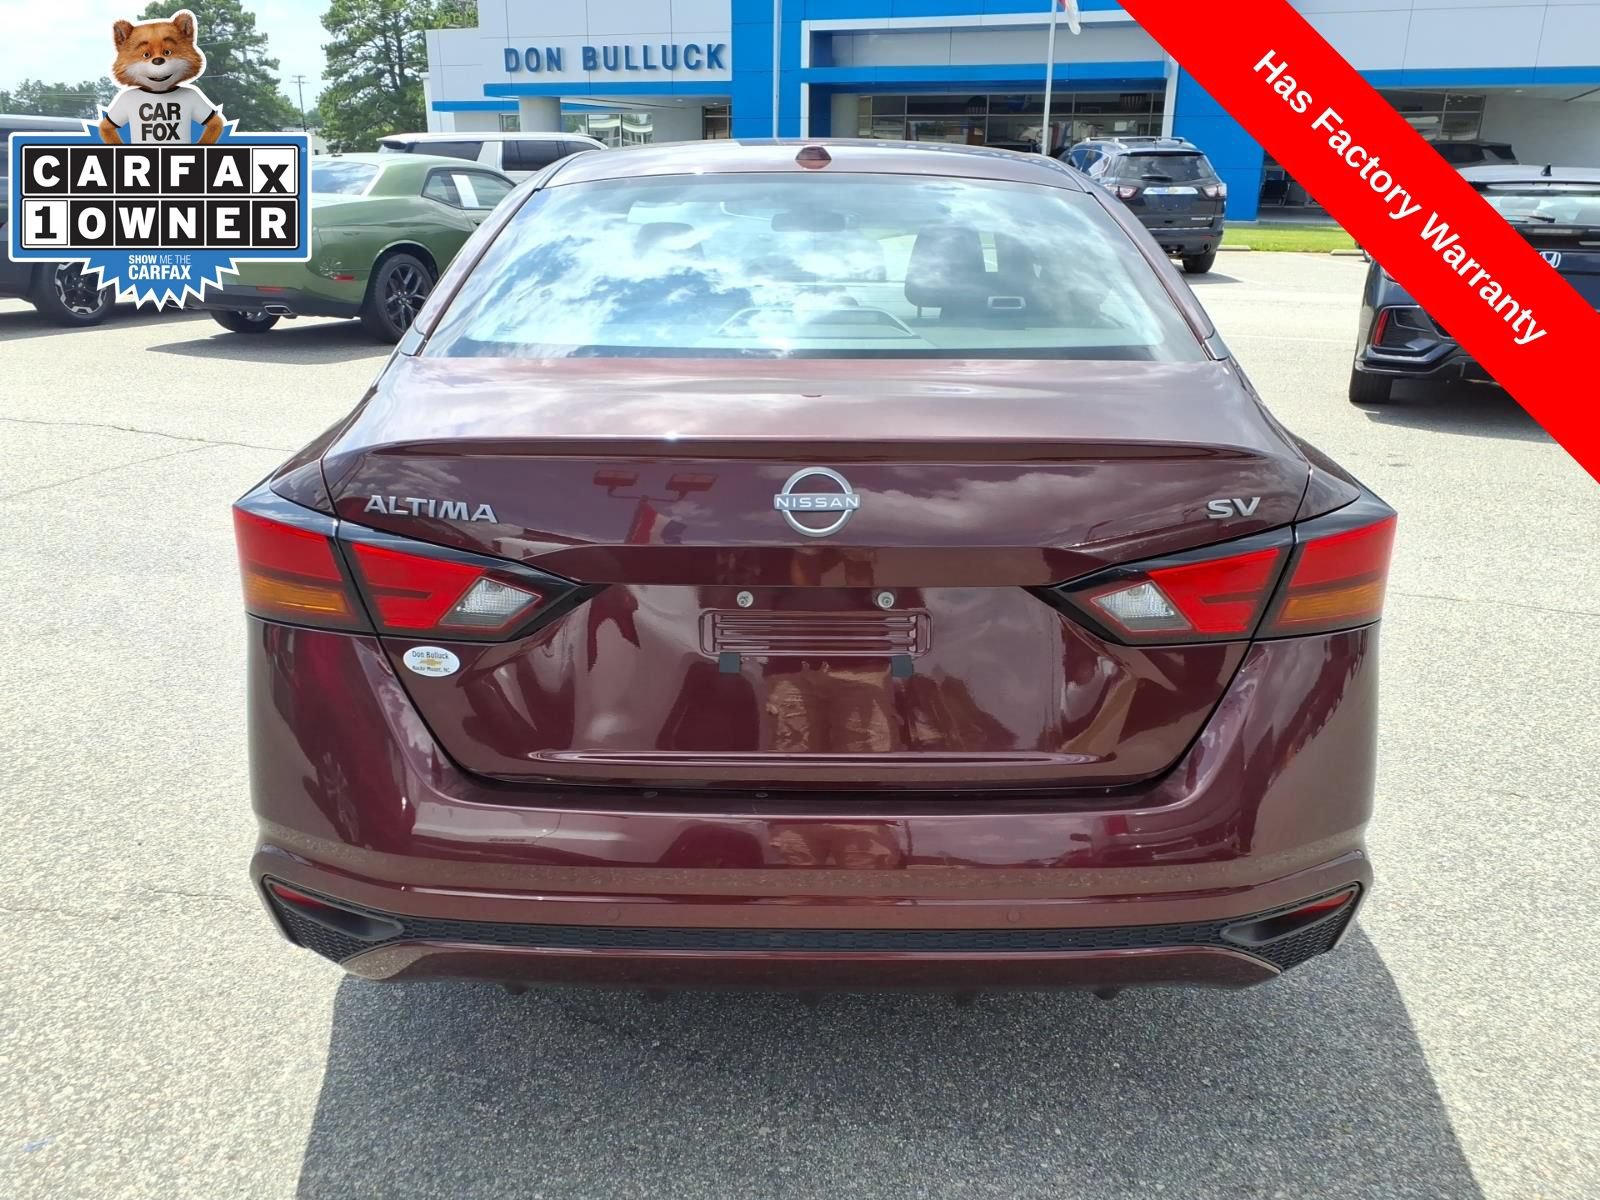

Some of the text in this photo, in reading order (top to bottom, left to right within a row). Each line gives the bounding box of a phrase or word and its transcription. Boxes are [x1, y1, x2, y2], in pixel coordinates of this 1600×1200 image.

[504, 44, 726, 72] DON BULLUCK
[364, 494, 498, 524] ALTIMA
[776, 497, 859, 508] NISSAN
[1207, 496, 1261, 519] SV
